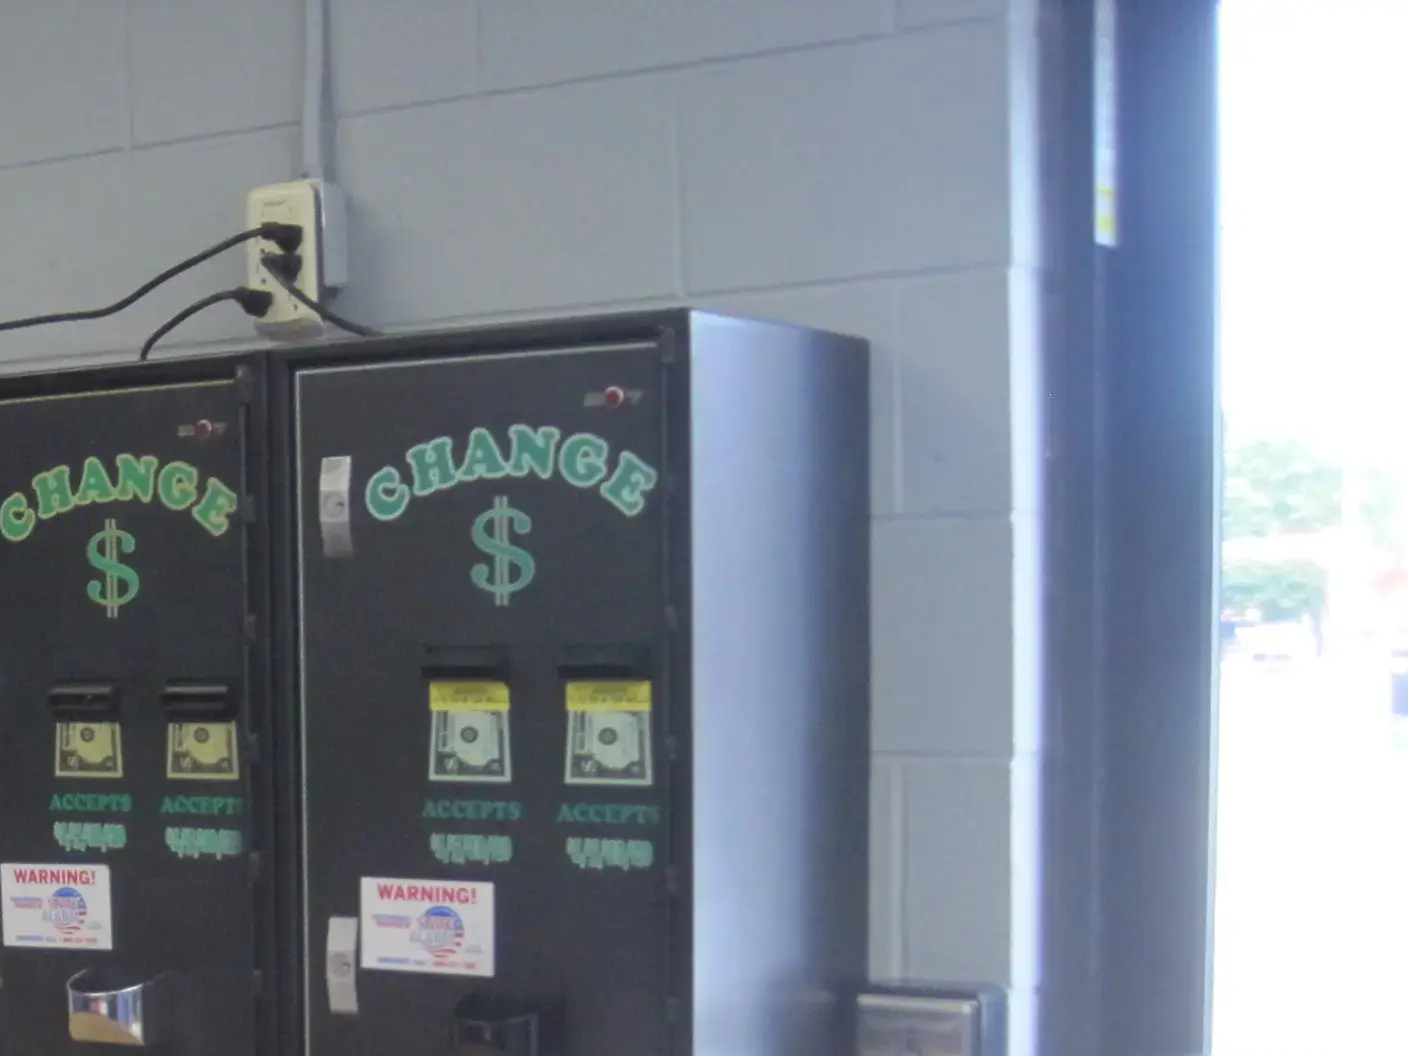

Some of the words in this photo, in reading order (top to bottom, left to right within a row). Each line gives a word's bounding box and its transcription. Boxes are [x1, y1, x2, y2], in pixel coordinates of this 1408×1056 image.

[365, 424, 658, 520] CHANGE
[13, 868, 97, 886] WARNING!
[376, 882, 478, 905] WARNING!
